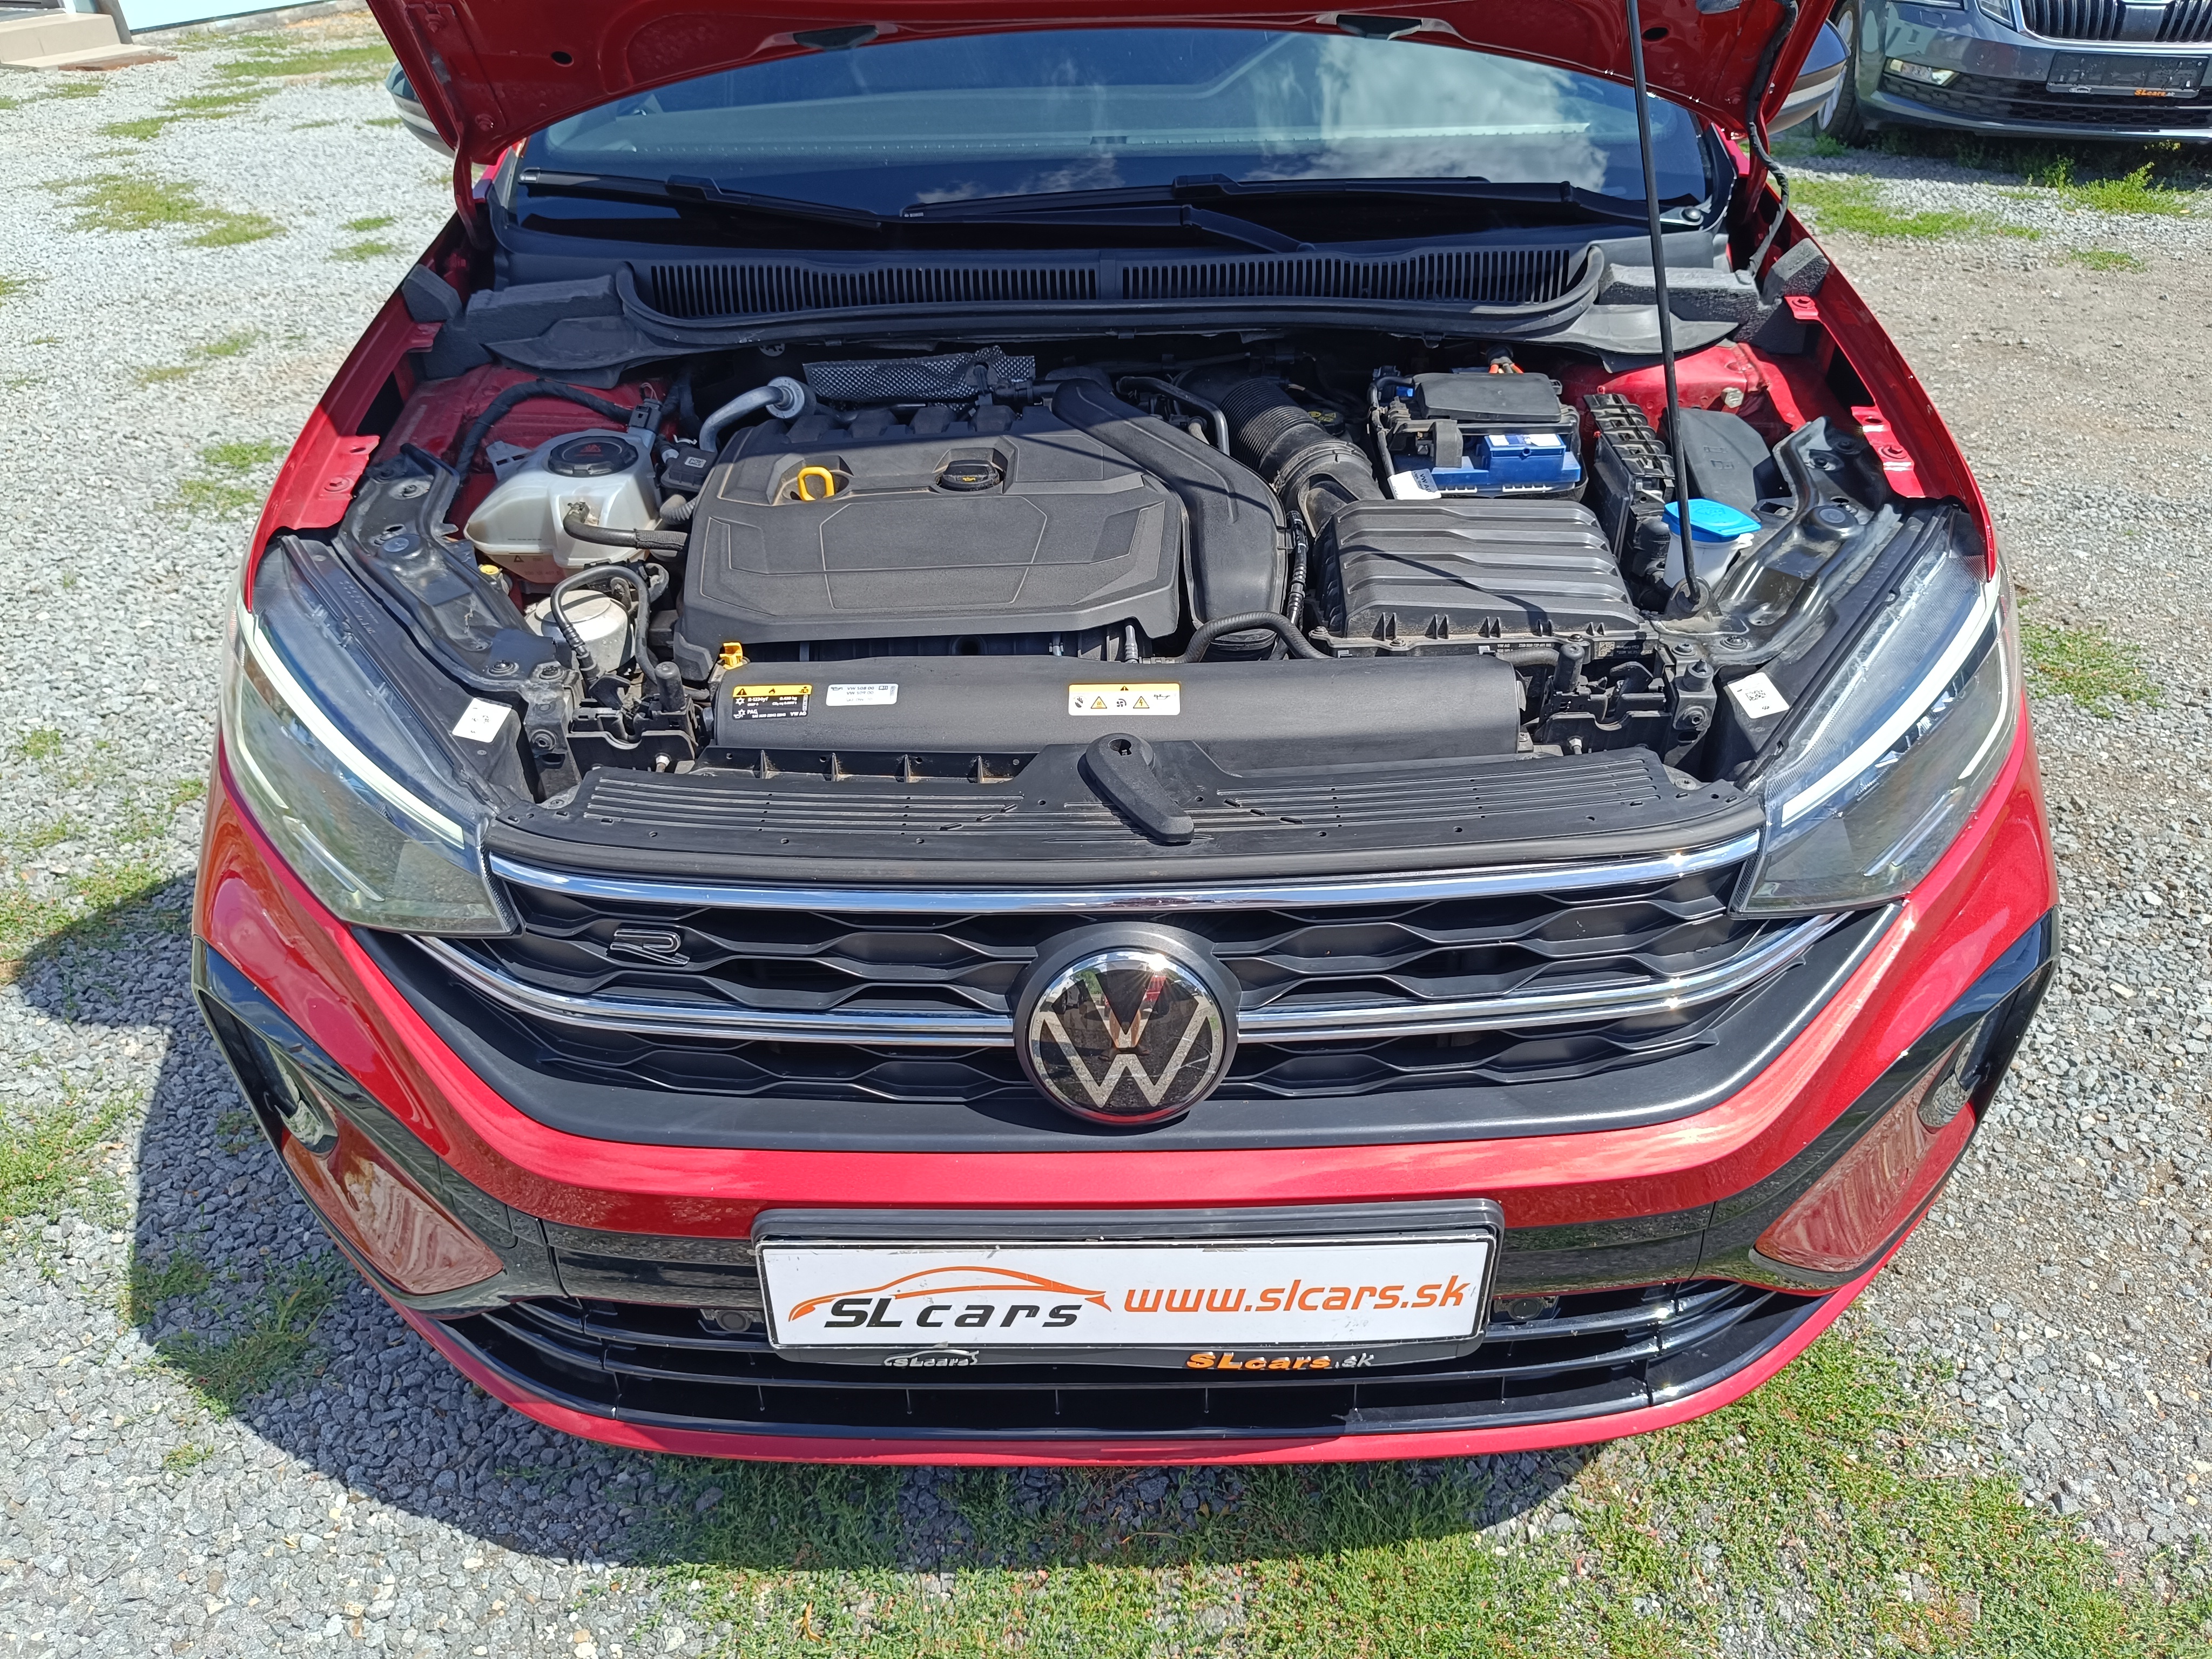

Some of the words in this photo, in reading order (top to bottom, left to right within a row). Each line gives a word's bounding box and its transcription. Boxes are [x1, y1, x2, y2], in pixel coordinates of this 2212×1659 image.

[1029, 952, 1223, 1109] VW
[1124, 1276, 1471, 1312] www.slcars.sk
[1187, 1351, 1374, 1370] SLcars.sk
